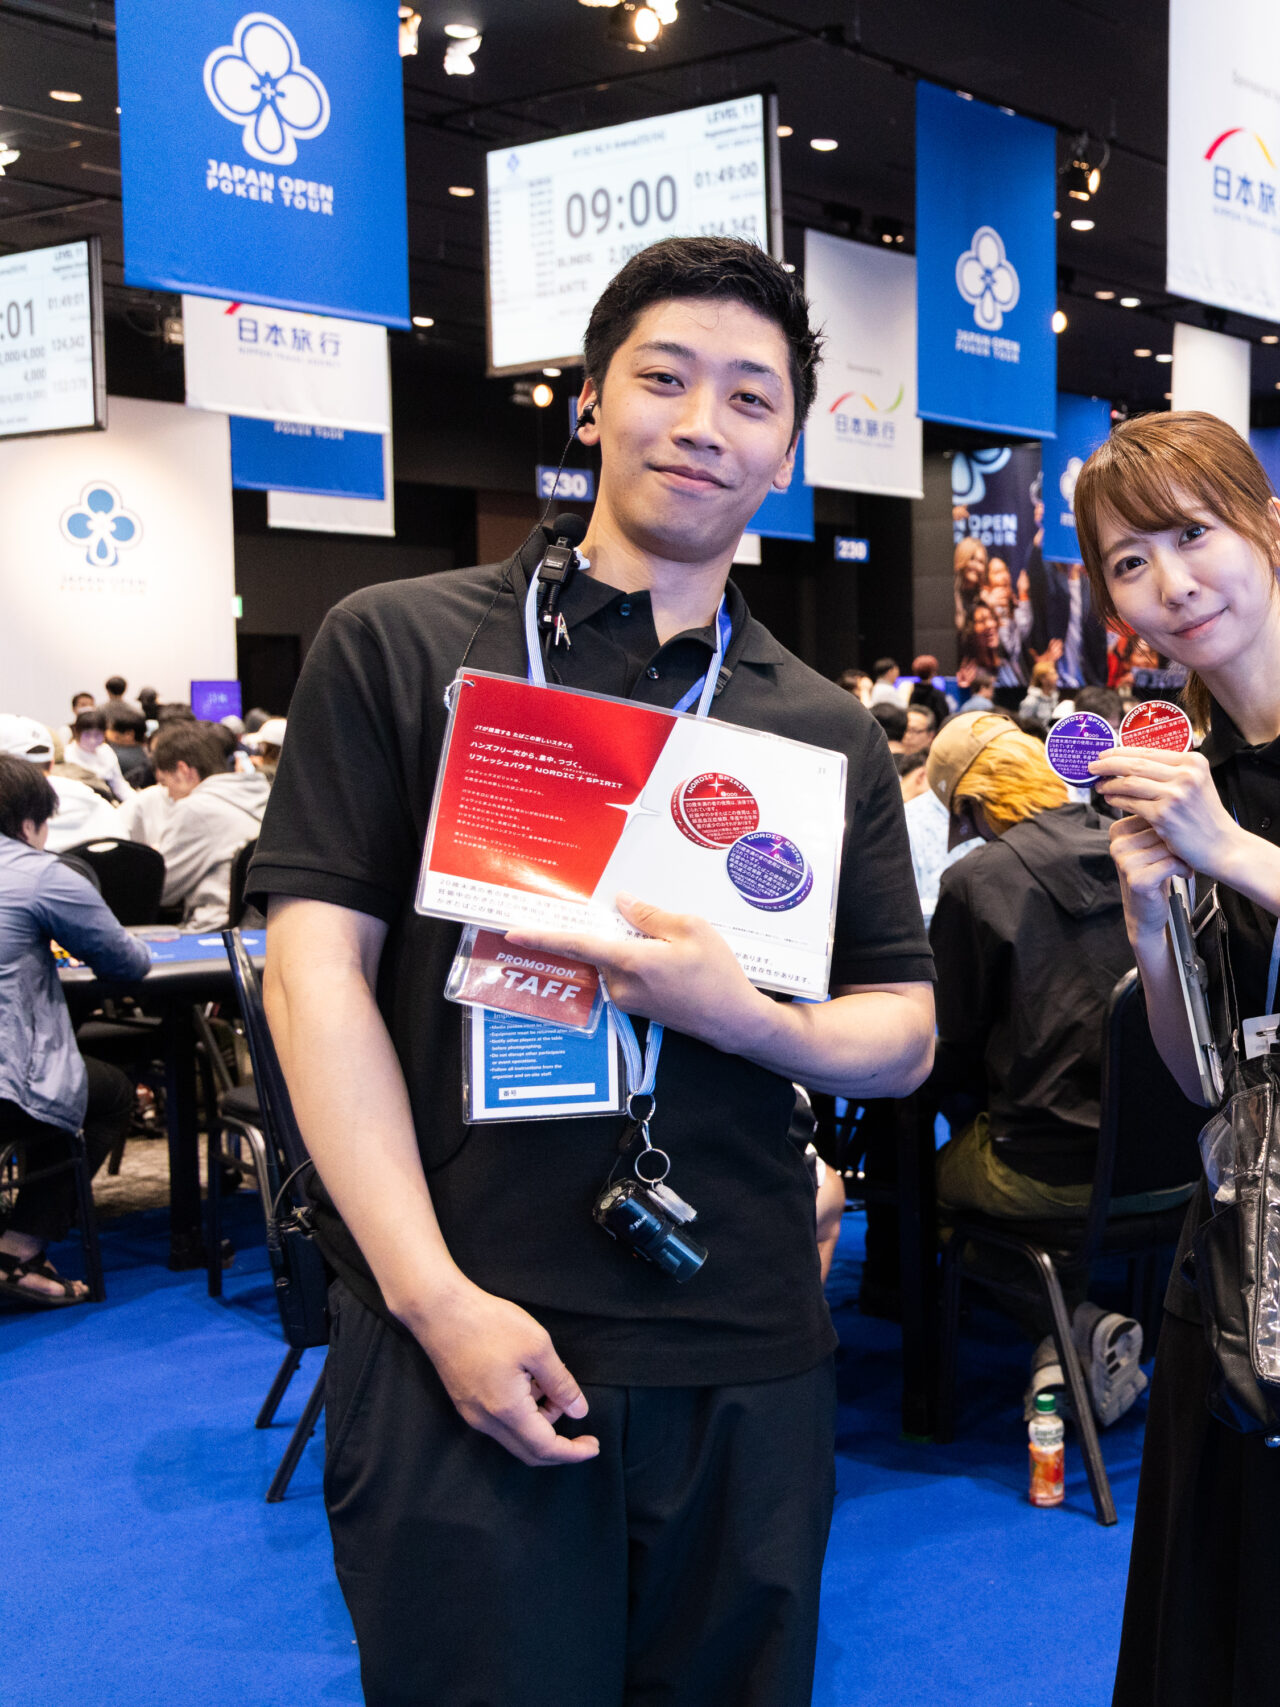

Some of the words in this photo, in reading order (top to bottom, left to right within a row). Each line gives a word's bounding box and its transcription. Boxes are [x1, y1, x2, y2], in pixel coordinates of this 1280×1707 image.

[206, 159, 274, 190] JAPAN
[278, 176, 333, 203] OPEN
[695, 161, 759, 188] 01:49:00
[206, 176, 274, 204] POKER
[282, 192, 333, 216] TOUR
[566, 174, 677, 239] 09:00
[238, 318, 341, 357] 日本旅行
[835, 413, 896, 441] 日本旅行
[542, 471, 588, 498] 330
[969, 514, 1018, 532] OPEN
[1056, 715, 1084, 732] NORDIC
[1087, 715, 1111, 735] SPIRIT
[1124, 705, 1147, 728] NORDIC
[1151, 703, 1179, 715] SPIRIT
[470, 741, 583, 769] ハンズフリーだから、集中、つづく。
[469, 753, 533, 771] リフレッシュパウチ
[535, 766, 575, 780] NORDIC
[585, 777, 623, 789] SPIRIT
[686, 774, 714, 794] NORDIC
[718, 774, 748, 793] SPIRIT
[747, 833, 782, 841] NORDIC
[784, 840, 803, 867] SPIRIT
[496, 952, 577, 979] PROMOTION
[482, 965, 581, 1002] STAFF
